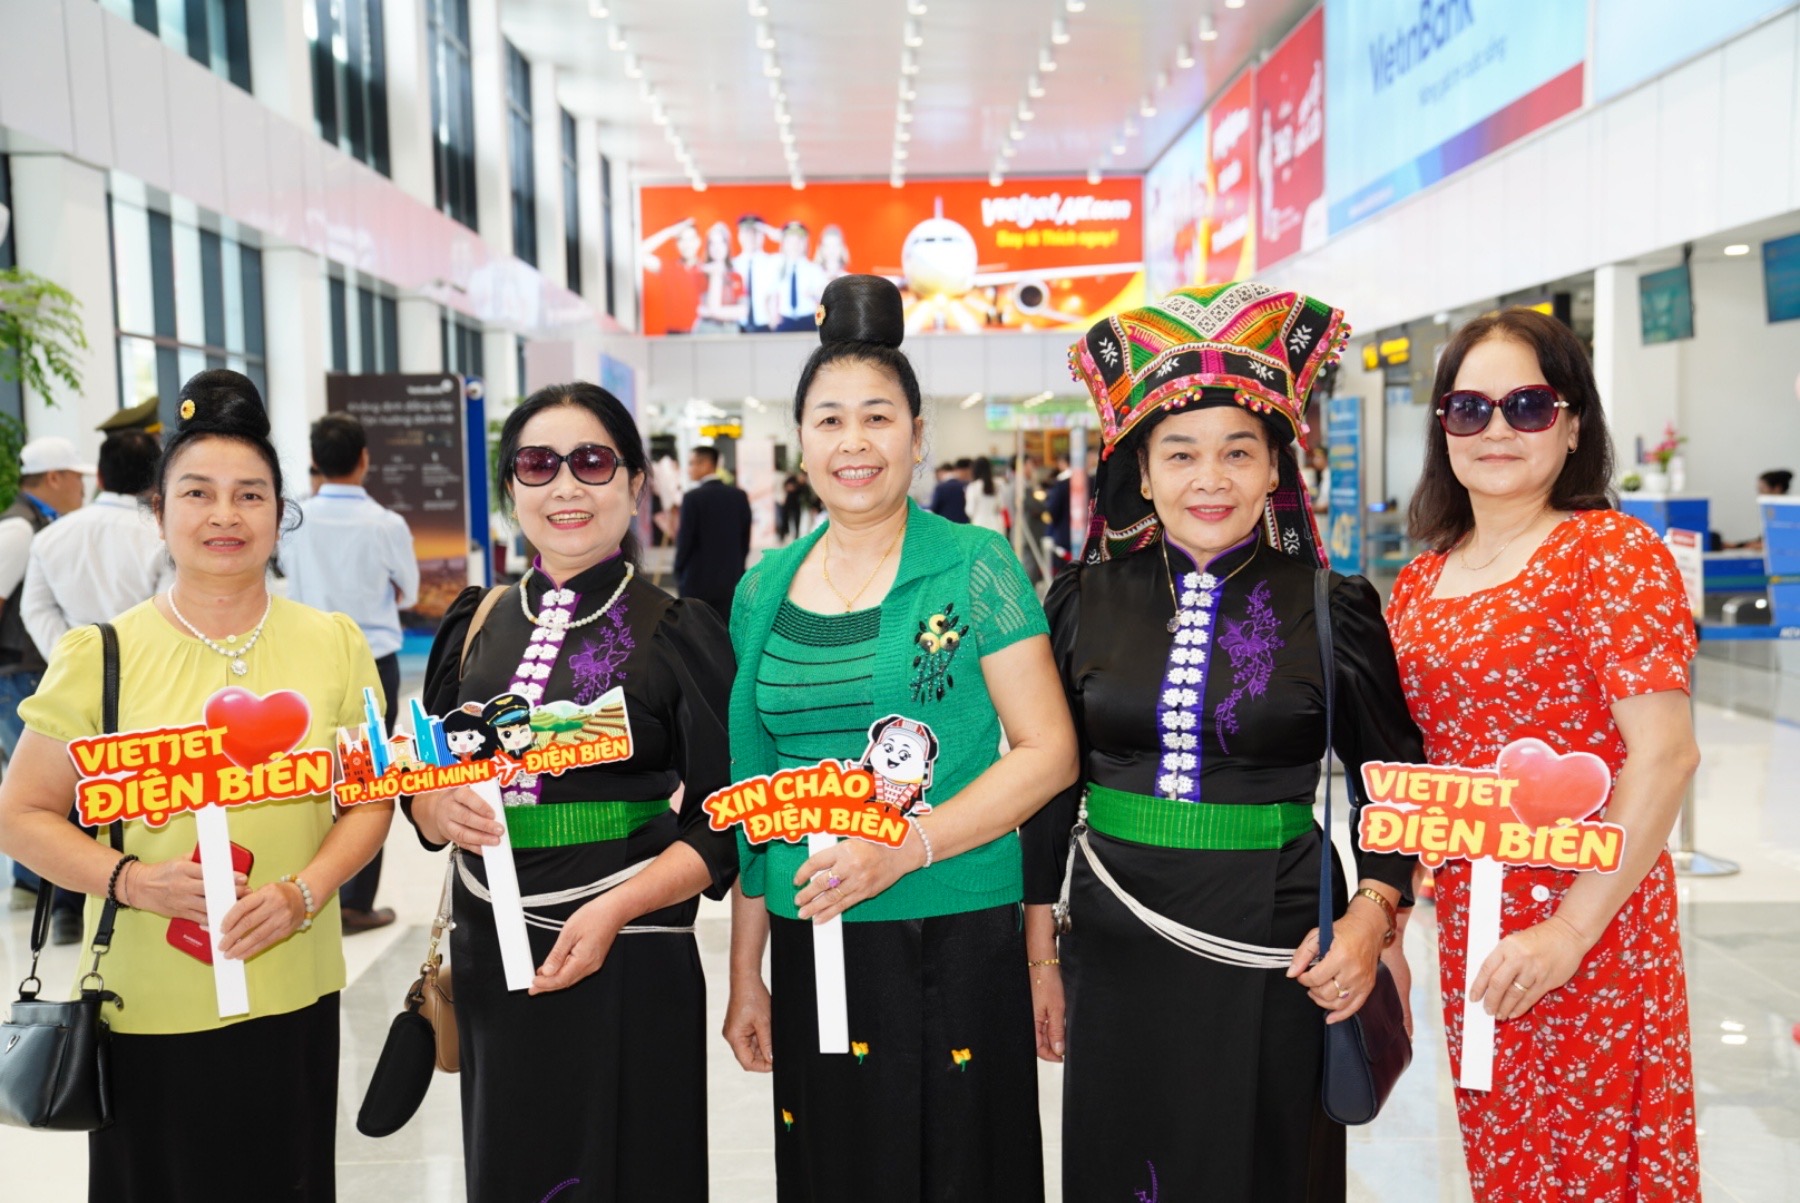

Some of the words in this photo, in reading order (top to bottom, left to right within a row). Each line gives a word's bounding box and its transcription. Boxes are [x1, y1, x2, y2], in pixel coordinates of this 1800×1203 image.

[76, 726, 228, 772] VIETJET
[525, 746, 578, 774] ĐIỆN
[582, 735, 628, 760] BIÊN
[84, 768, 204, 822] ĐIỆN
[217, 752, 328, 802] BIÊN
[337, 784, 368, 804] TP.
[369, 770, 398, 797] HỒ
[402, 769, 434, 792] CHÍ
[437, 762, 490, 787] MINH
[710, 783, 767, 824] XIN
[773, 767, 870, 801] CHÀO
[1368, 769, 1519, 809] VIETJET
[750, 803, 821, 837] ĐIỆN
[829, 807, 904, 842] BIÊN
[1366, 806, 1486, 862] ĐIỆN
[1497, 818, 1618, 868] BIÊN
